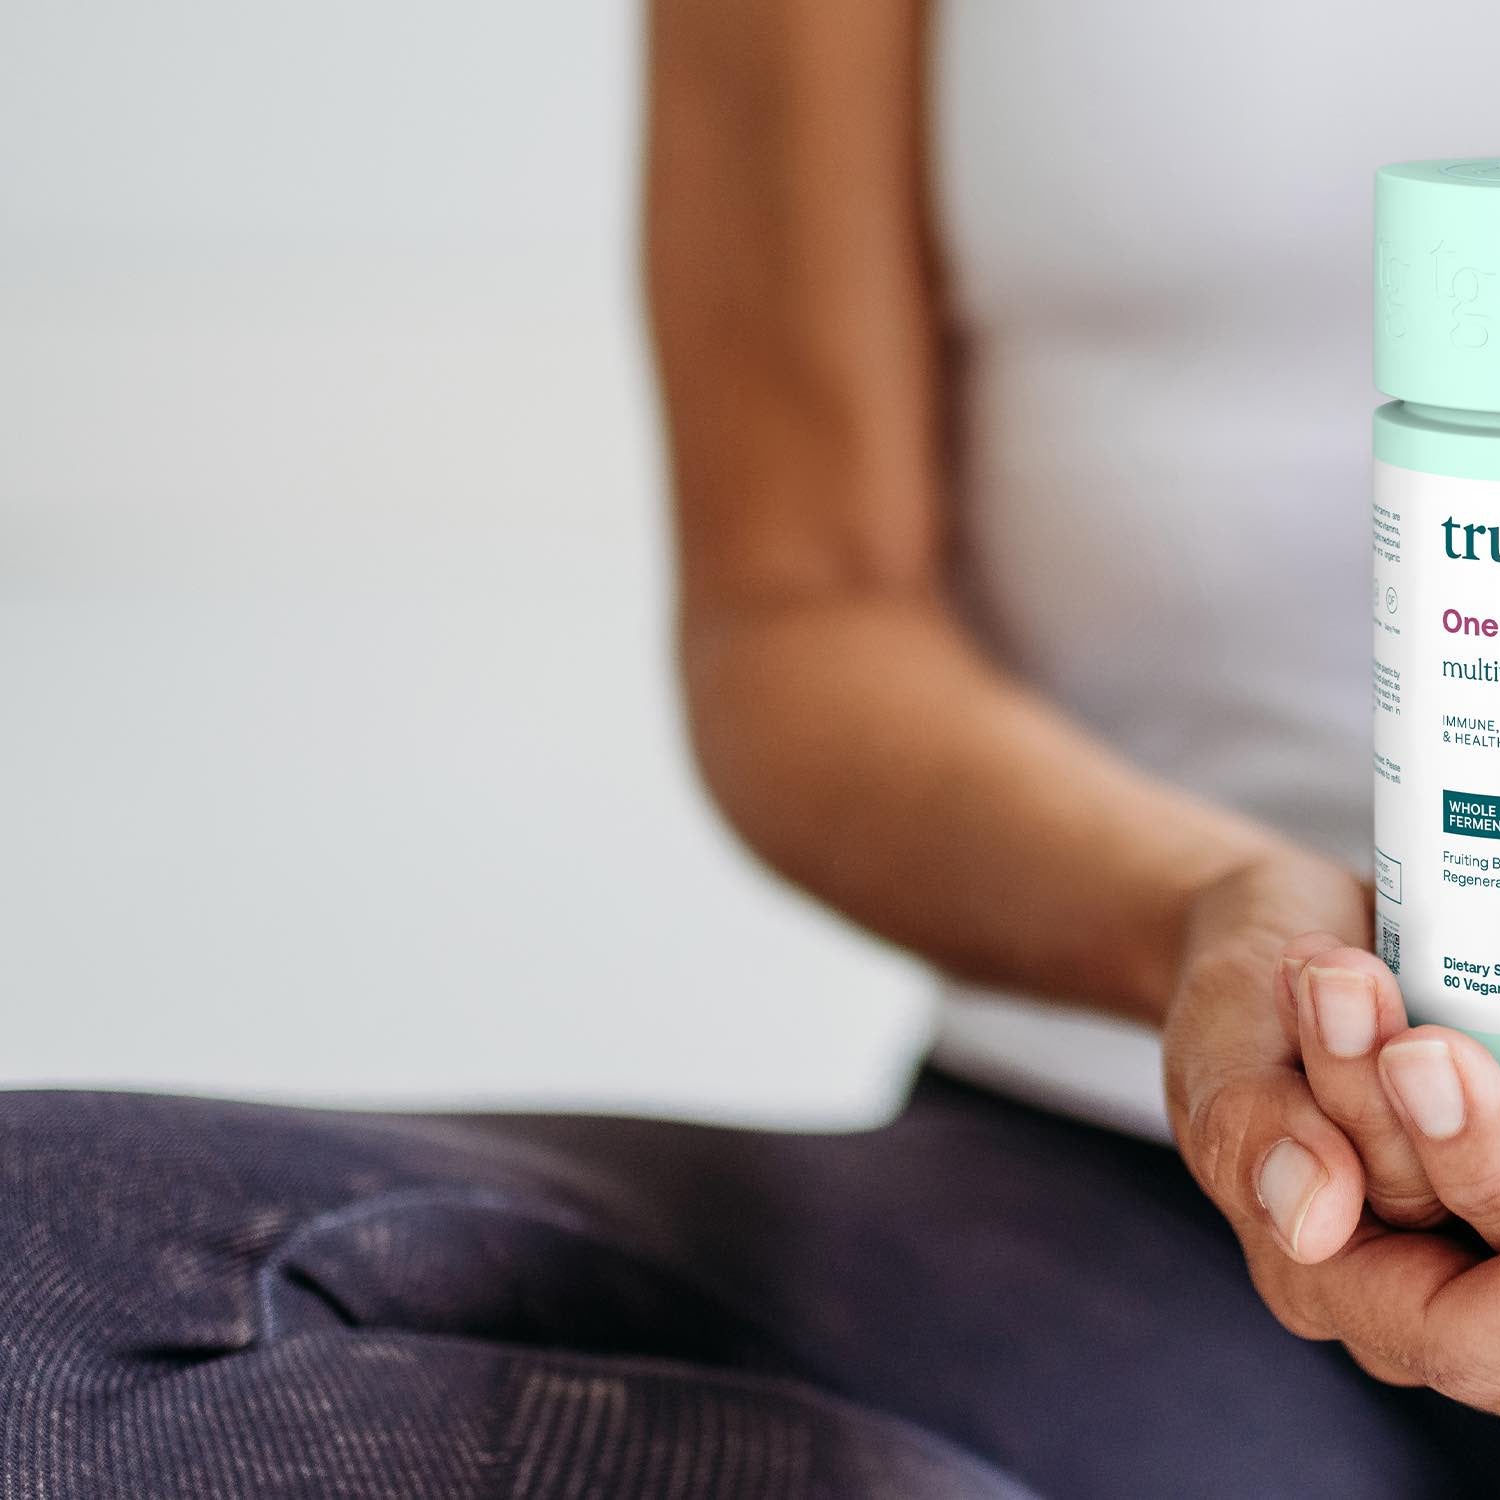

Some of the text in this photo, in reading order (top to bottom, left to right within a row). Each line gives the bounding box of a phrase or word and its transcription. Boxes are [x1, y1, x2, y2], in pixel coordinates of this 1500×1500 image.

[1442, 608, 1499, 638] One
[1442, 714, 1500, 734] IMMUNE,
[1442, 731, 1452, 743] &
[1449, 799, 1497, 818] WHOLE
[1442, 850, 1489, 871] Fruiting
[1443, 956, 1490, 978] Dietary
[1443, 975, 1461, 988] 60
